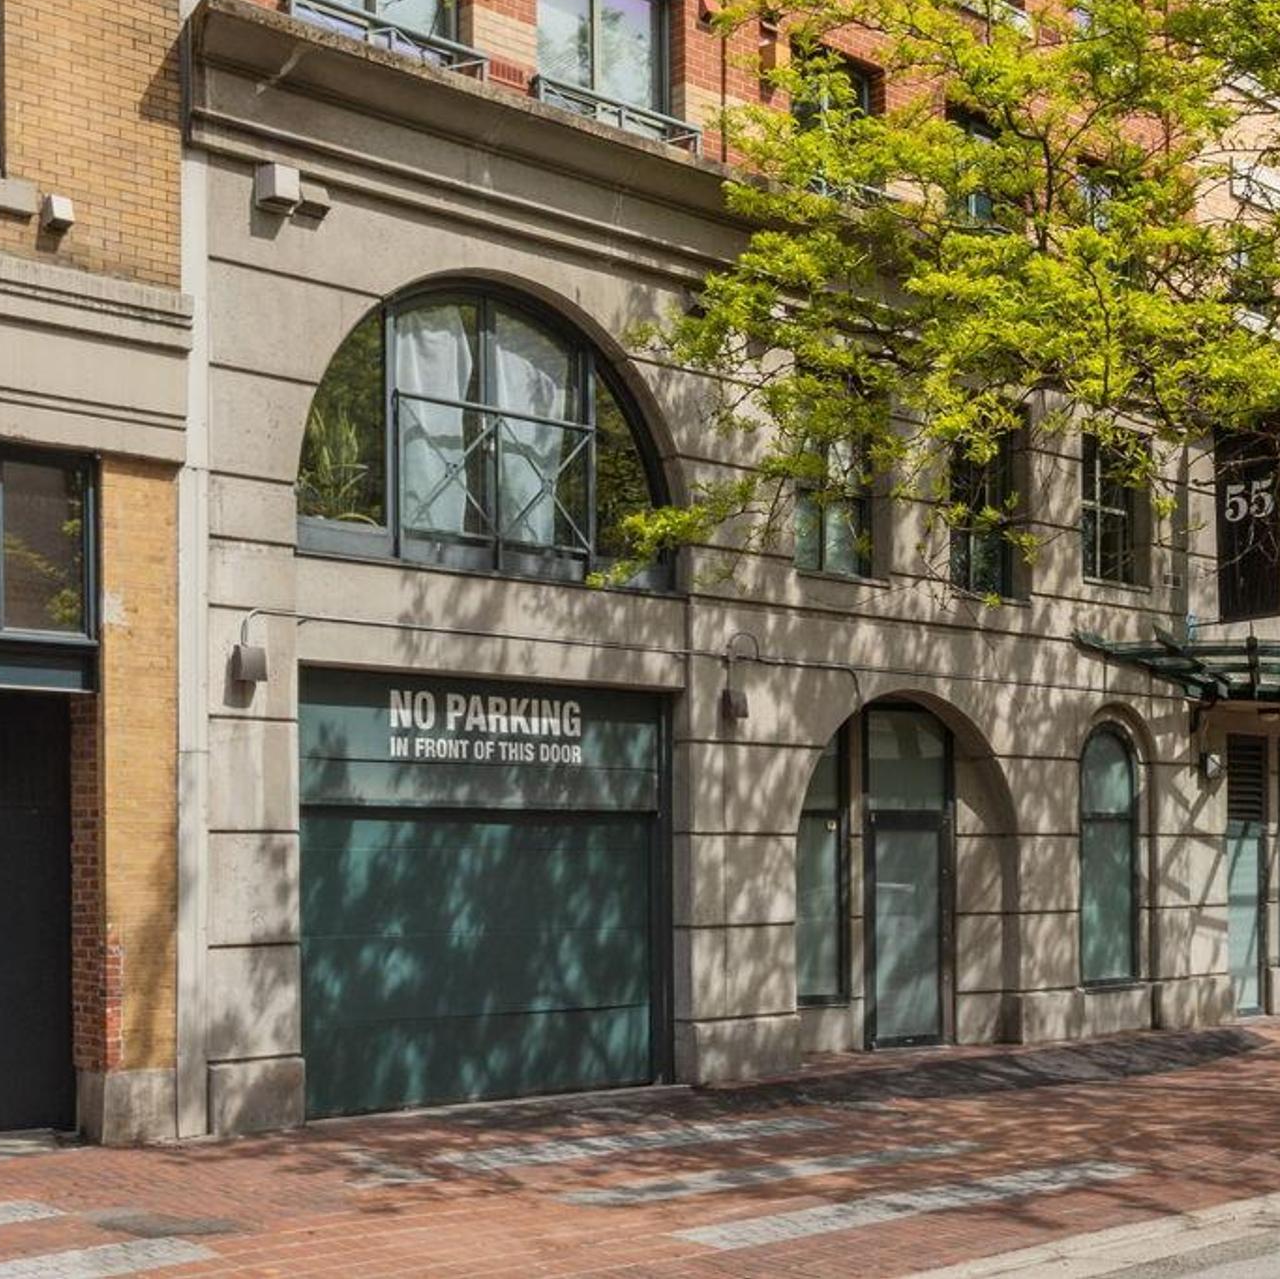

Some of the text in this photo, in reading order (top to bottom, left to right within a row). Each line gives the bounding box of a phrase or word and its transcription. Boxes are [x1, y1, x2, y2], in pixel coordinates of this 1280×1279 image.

[1224, 478, 1275, 522] 55
[389, 689, 582, 737] NO PARKING
[389, 736, 583, 764] IN FRONT OF THIS DOOR
